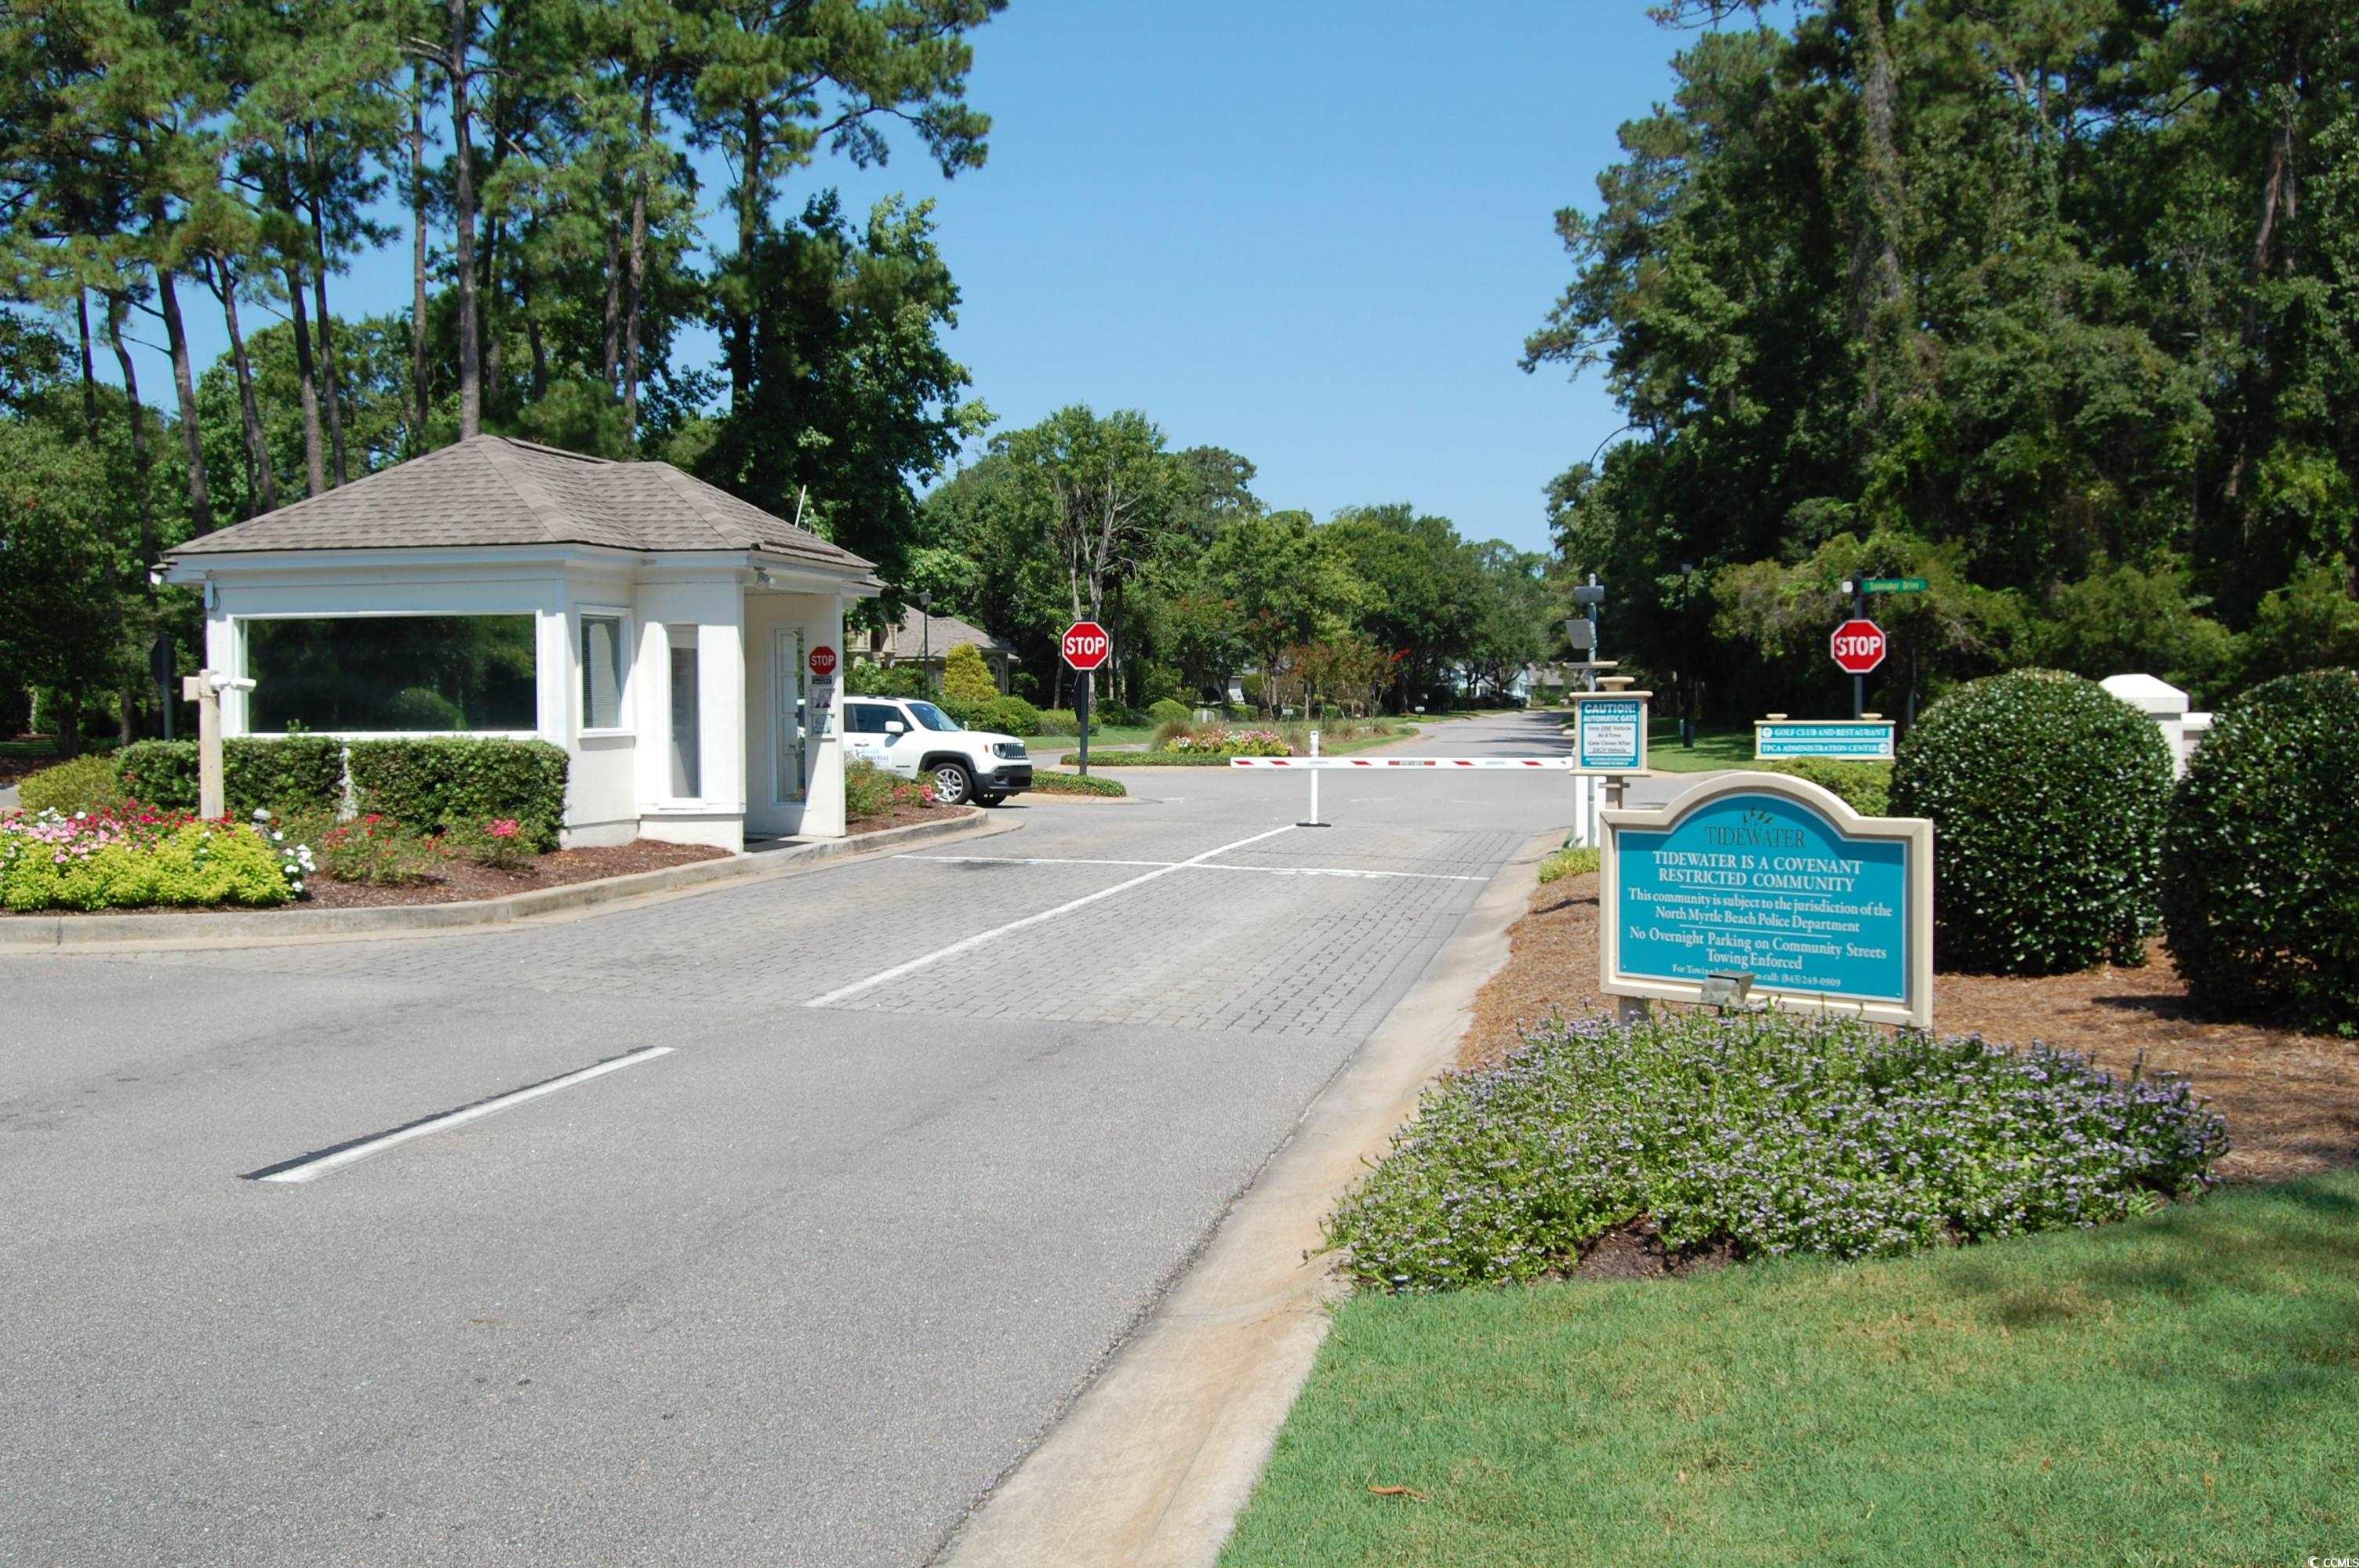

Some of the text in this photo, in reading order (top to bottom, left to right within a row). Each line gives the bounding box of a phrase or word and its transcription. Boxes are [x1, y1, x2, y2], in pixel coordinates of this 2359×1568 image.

[1066, 637, 1105, 655] STOP
[1835, 636, 1881, 656] STOP
[811, 655, 834, 666] STOP
[1584, 703, 1636, 713] CAUTION!
[1705, 826, 1805, 848] TIDEWATER
[1653, 851, 1863, 875] TIDEWATER IS A COVENANT
[1659, 868, 1856, 892] RESTRICTED COMMUNITY
[1628, 887, 1892, 917] This community is subject to the jurisdiction of the
[1656, 906, 1860, 933] North Myrtle Beach Police Department
[1629, 926, 1888, 960] No Overnight Parking on Community Streets
[1672, 964, 1685, 973] For
[1706, 948, 1802, 970] Towing Enforced
